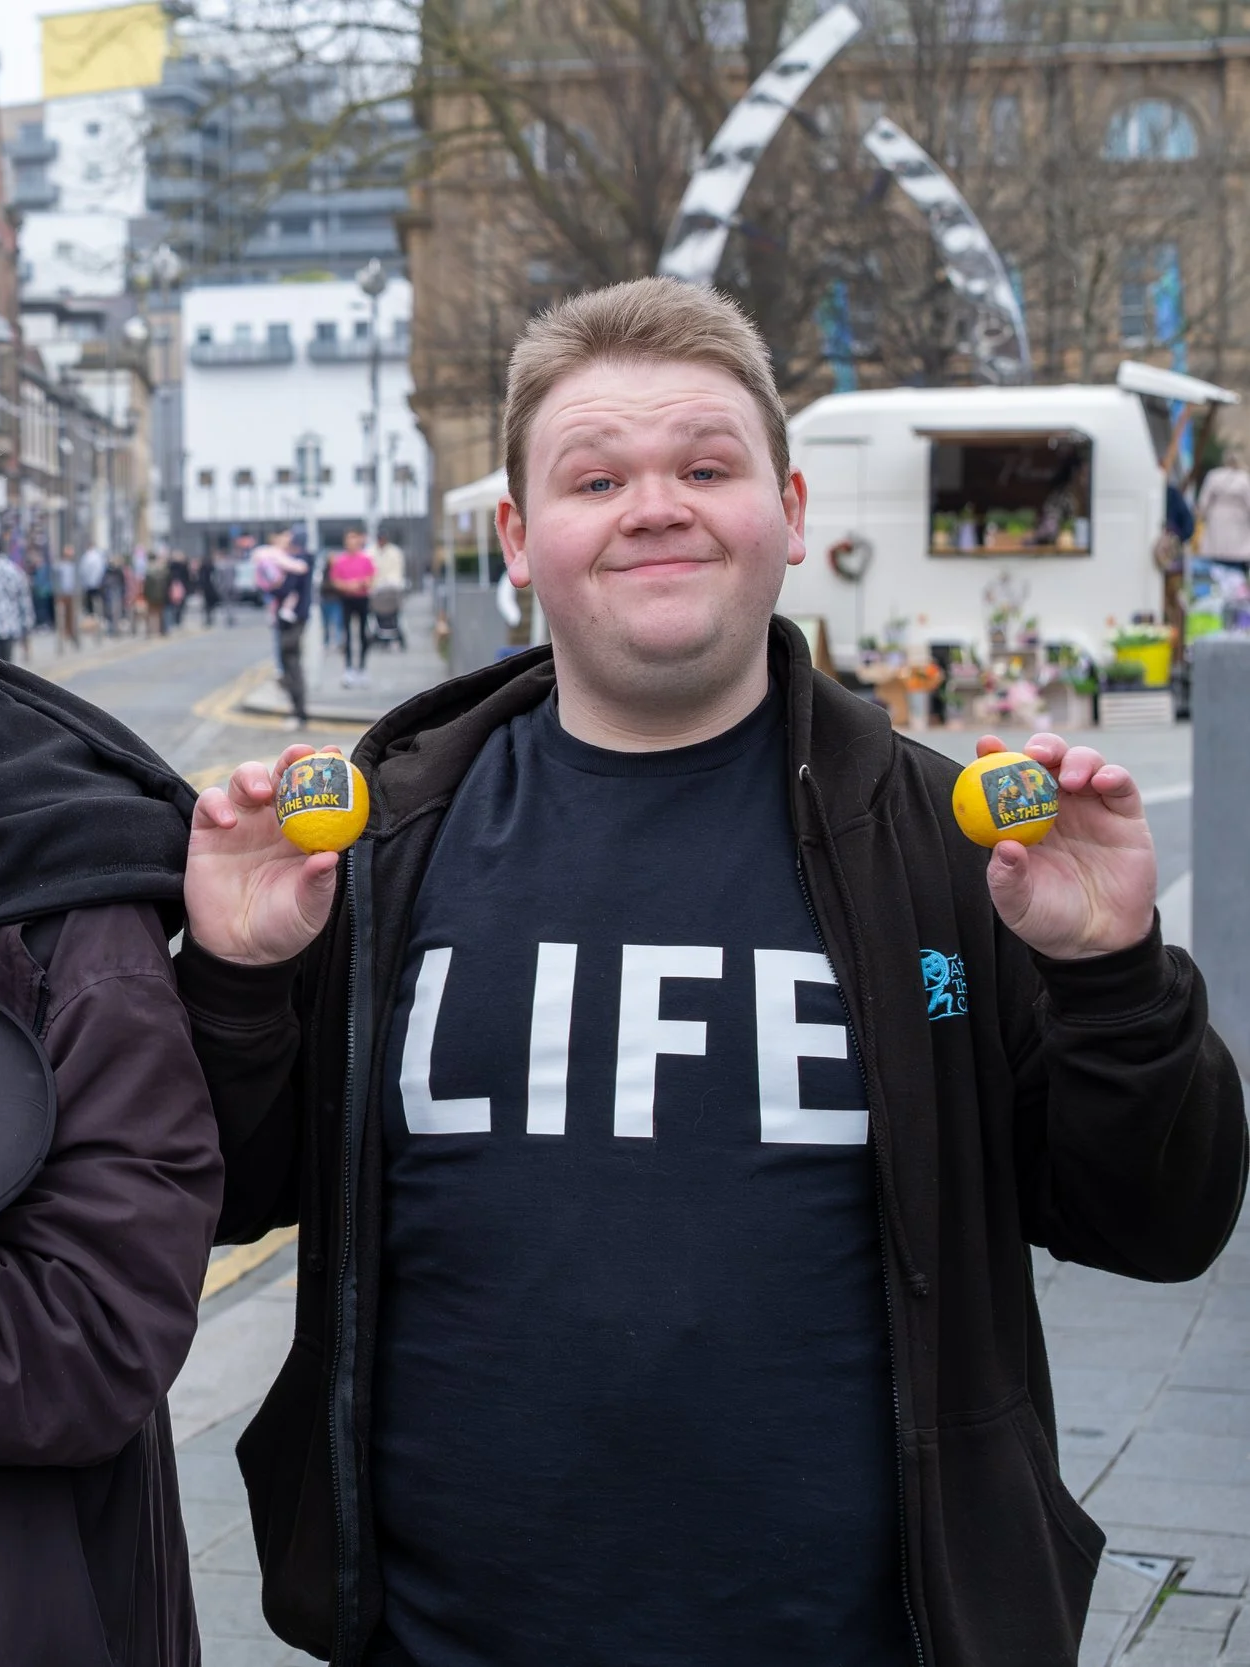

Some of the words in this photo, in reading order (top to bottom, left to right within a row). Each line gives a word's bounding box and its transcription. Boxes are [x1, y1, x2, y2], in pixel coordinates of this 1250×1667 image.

[285, 797, 302, 812] THE
[304, 794, 339, 805] PARK
[999, 811, 1016, 824] IN
[1017, 804, 1039, 818] THE
[950, 958, 965, 976] At
[399, 942, 869, 1145] LIFE
